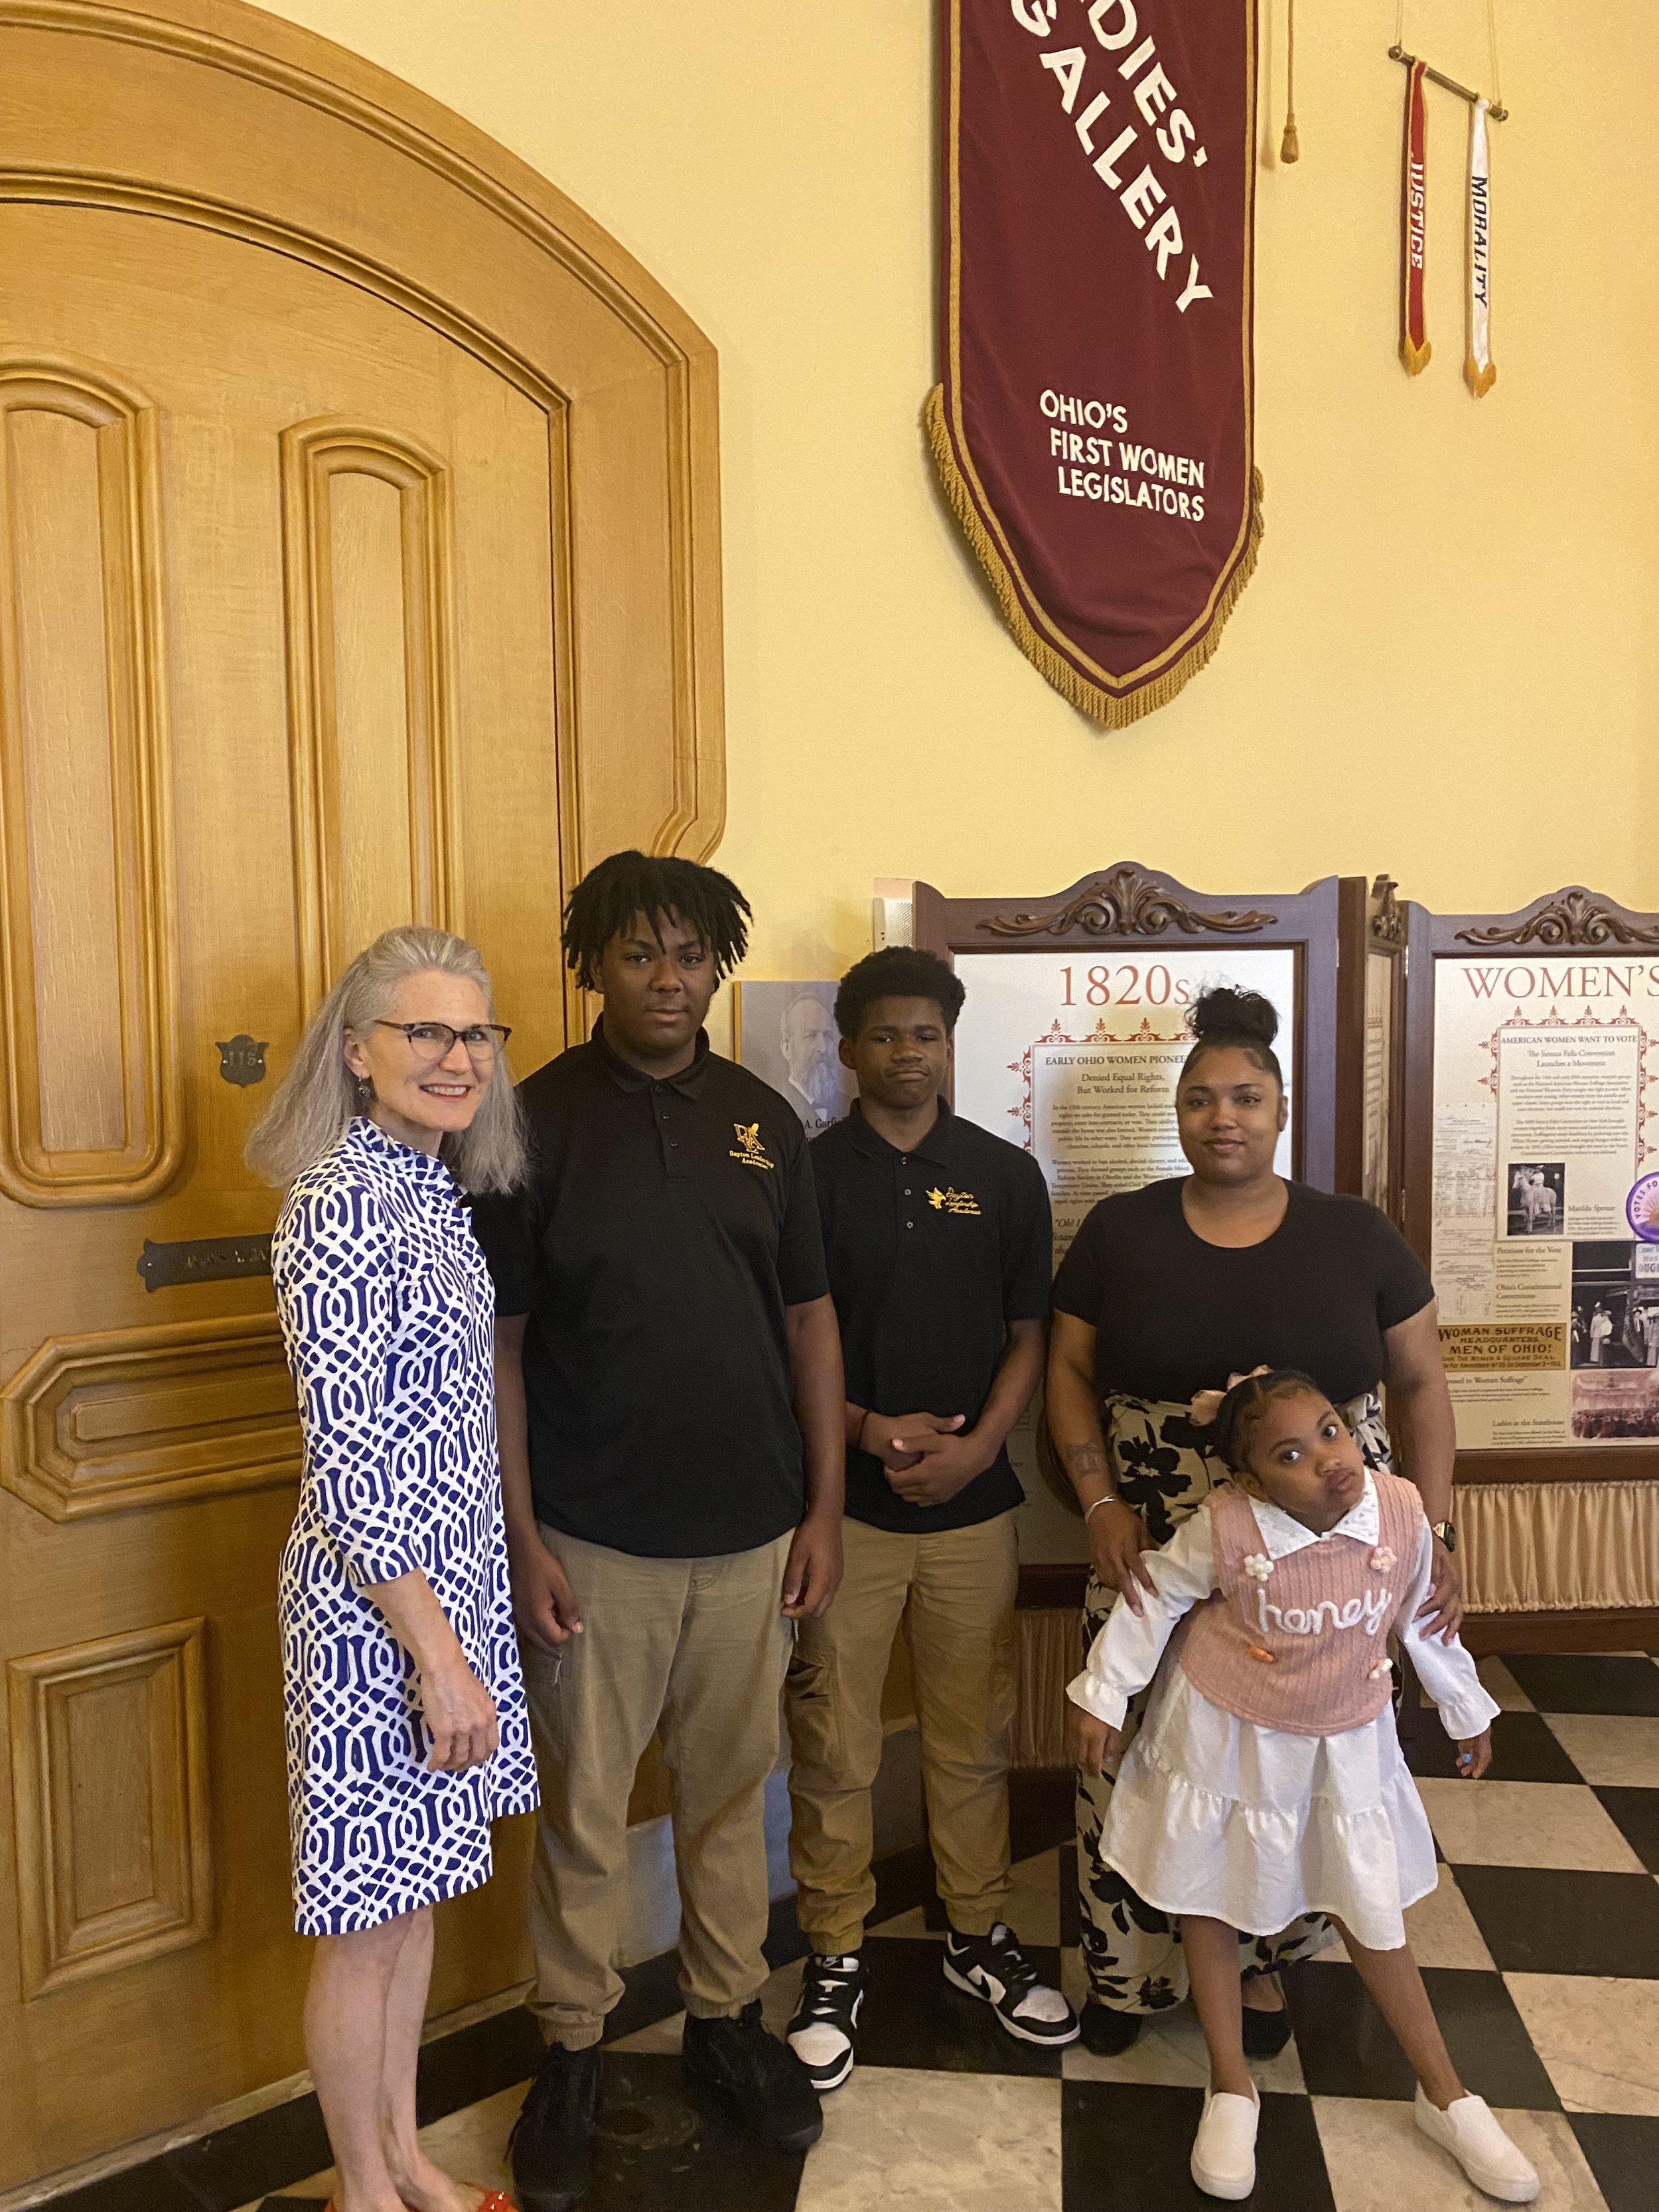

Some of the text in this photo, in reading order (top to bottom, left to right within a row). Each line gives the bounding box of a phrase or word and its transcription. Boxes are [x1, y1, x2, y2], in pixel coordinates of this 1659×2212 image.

[1081, 0, 1208, 167] DIES'
[1011, 0, 1214, 313] GALLERY
[1410, 152, 1425, 269] JUSTICE
[1471, 175, 1488, 309] MORALITY
[1040, 389, 1128, 433] OHIO'S
[1050, 427, 1204, 488] FIRST WOMEN
[1058, 466, 1204, 522] LEGISLATORS
[1060, 964, 1190, 1007] 1820s
[1461, 964, 1659, 999] WOMEN'S
[1045, 1057, 1075, 1065] EARLY
[1076, 1056, 1105, 1065] OHIO
[1107, 1055, 1147, 1064] WOMEN
[1081, 1072, 1165, 1083] Denied Equal Rights,
[1077, 1086, 1092, 1094] But
[1094, 1085, 1124, 1094] Worked
[1139, 1084, 1169, 1093] Reform
[1634, 1190, 1646, 1219] VOTES
[1438, 1326, 1561, 1342] WOMAN SUFFRAGE
[1449, 1345, 1483, 1355] MEN
[1488, 1344, 1508, 1354] OF
[1257, 1587, 1392, 1636] honey
